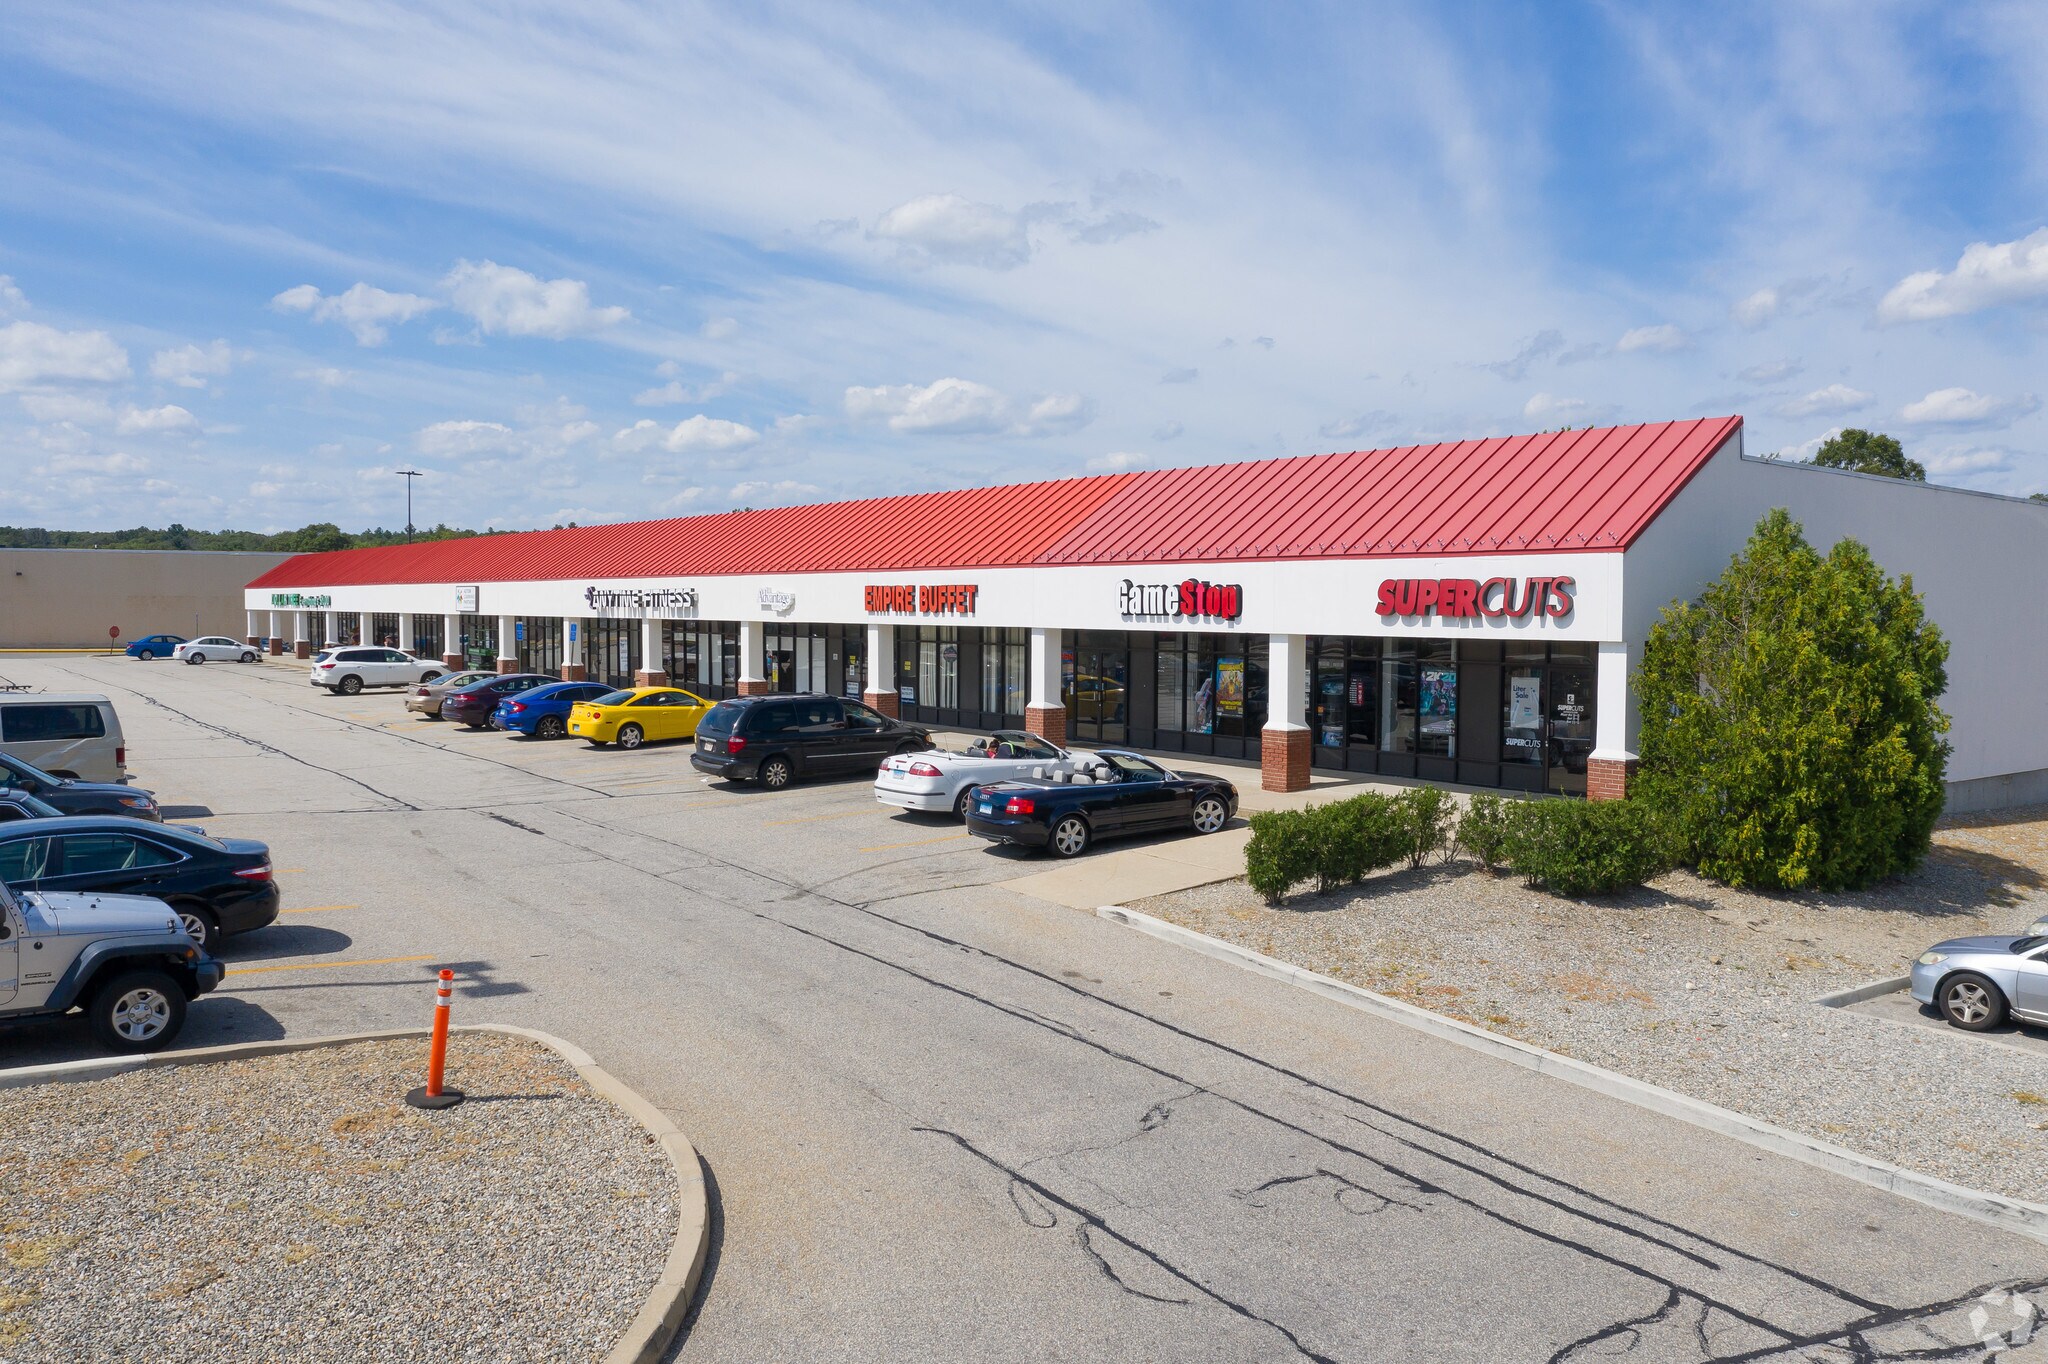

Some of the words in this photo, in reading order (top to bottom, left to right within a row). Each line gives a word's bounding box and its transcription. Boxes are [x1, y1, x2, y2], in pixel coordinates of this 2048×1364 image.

[592, 590, 641, 607] ANYTIME
[643, 589, 694, 607] FITNESS
[864, 585, 916, 613] EMPIRE
[919, 584, 979, 614] BUFFET
[1116, 578, 1243, 621] GameStop
[1375, 576, 1576, 618] SUPERCUTS
[1505, 737, 1541, 748] SUPERCUTS
